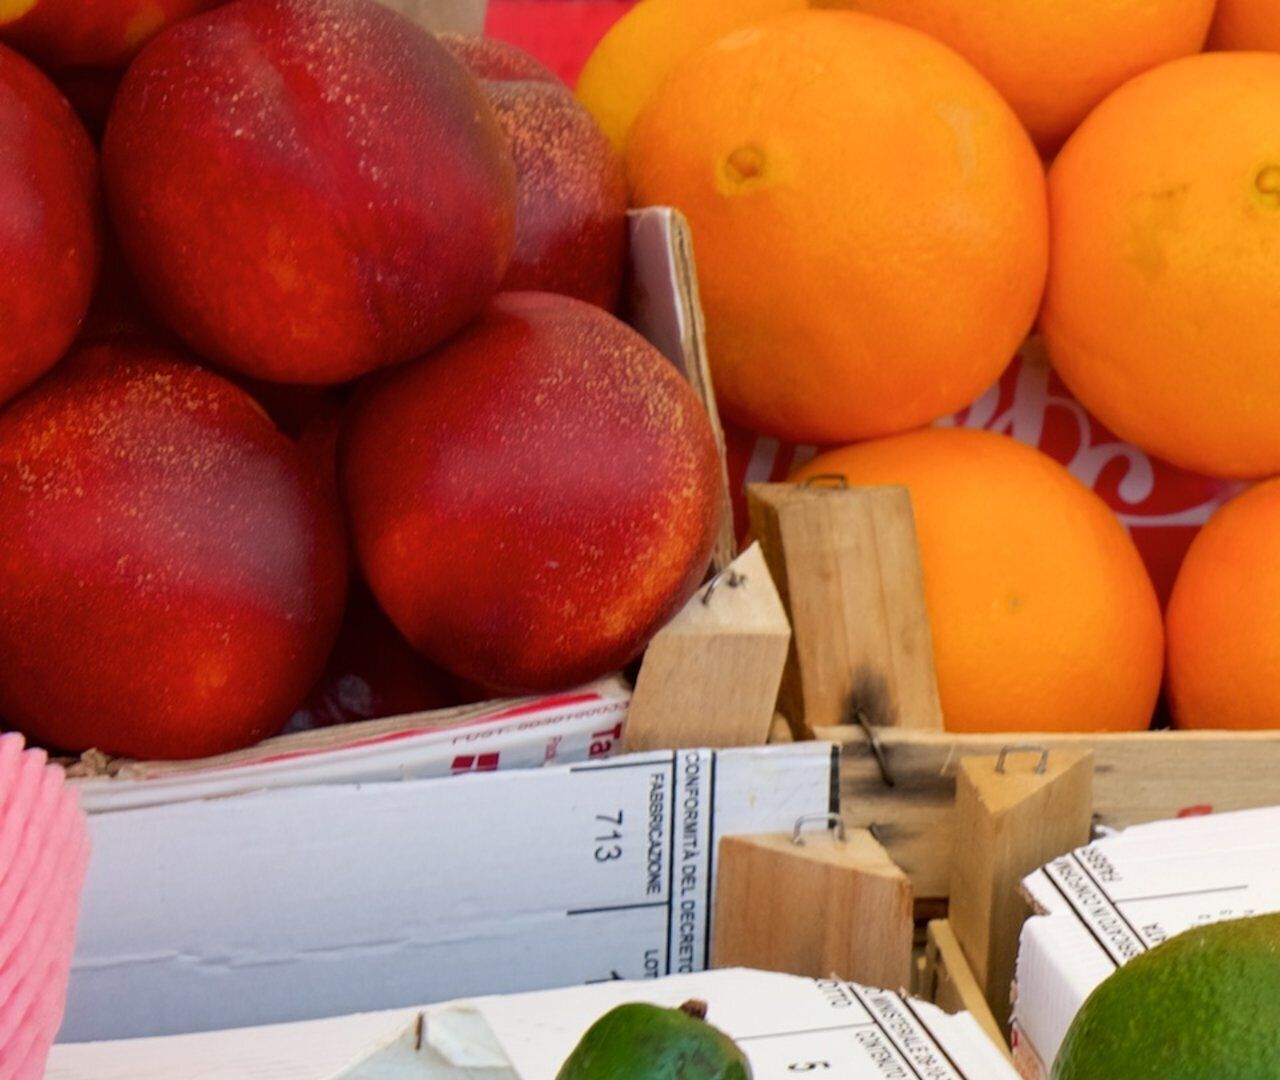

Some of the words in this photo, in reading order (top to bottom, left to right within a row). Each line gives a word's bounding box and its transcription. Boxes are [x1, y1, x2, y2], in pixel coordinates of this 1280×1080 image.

[594, 809, 624, 864] 713
[646, 772, 665, 896] FABBRICAZIONE
[680, 864, 697, 896] DEL
